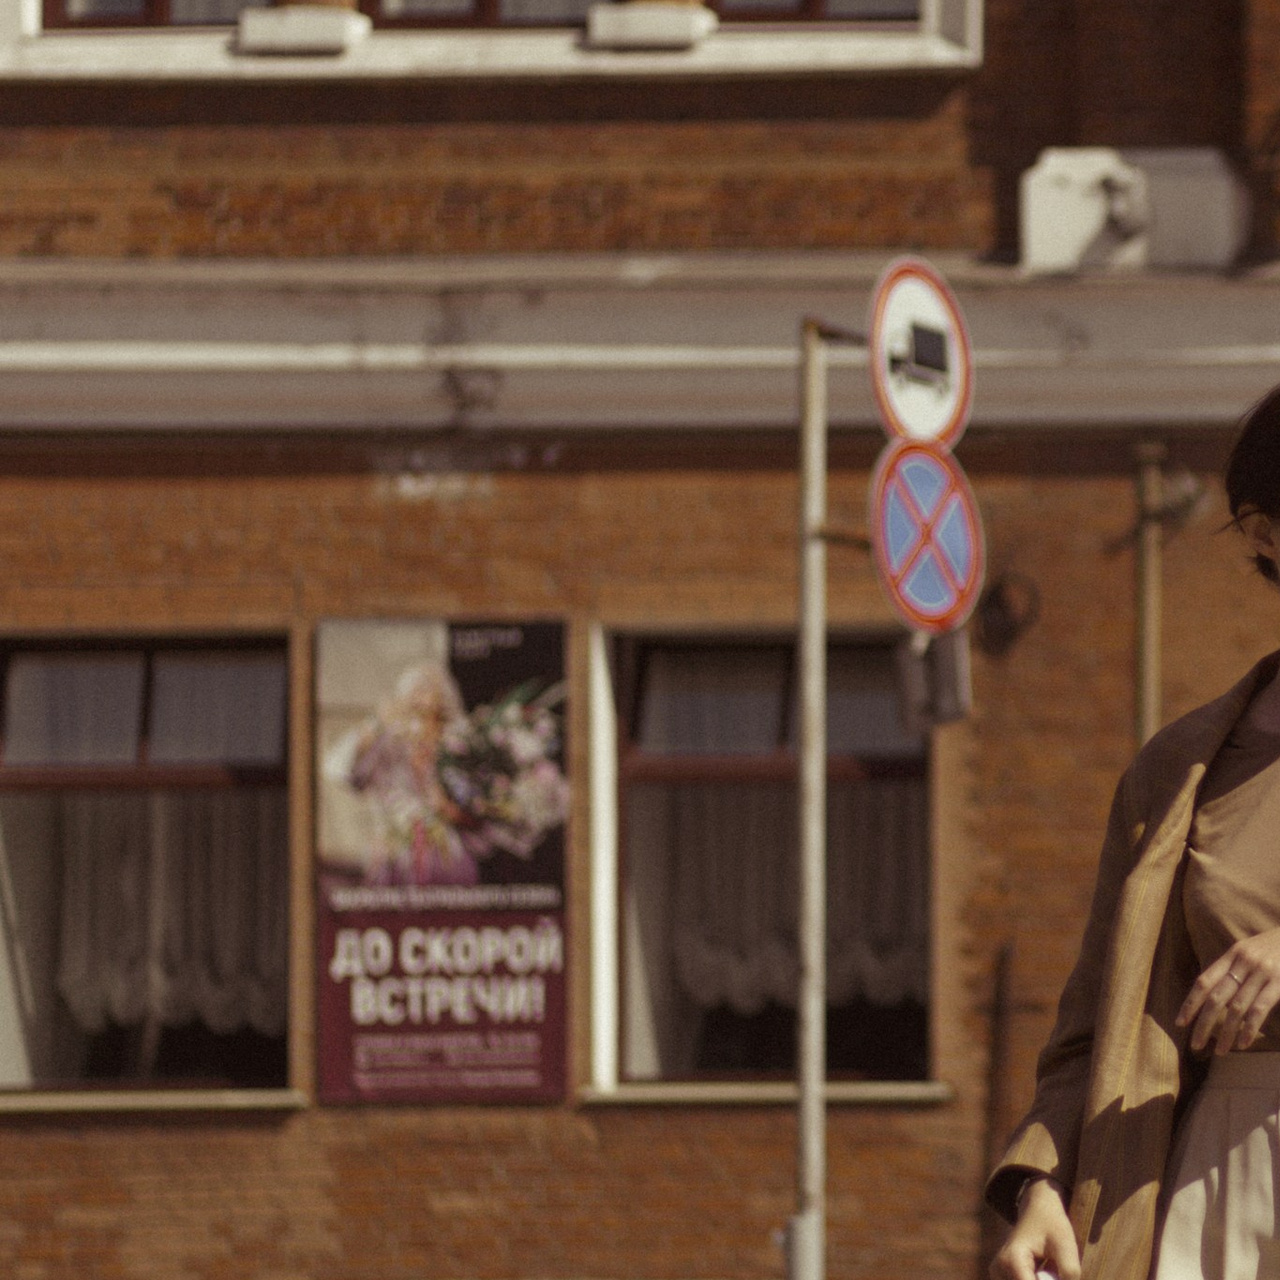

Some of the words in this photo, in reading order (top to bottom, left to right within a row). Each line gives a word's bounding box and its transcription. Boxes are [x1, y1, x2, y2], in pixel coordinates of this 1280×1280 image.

[329, 927, 392, 982] ДО
[400, 917, 563, 973] СКОРОЙ
[351, 976, 545, 1024] ВСТРЕЧИ!
